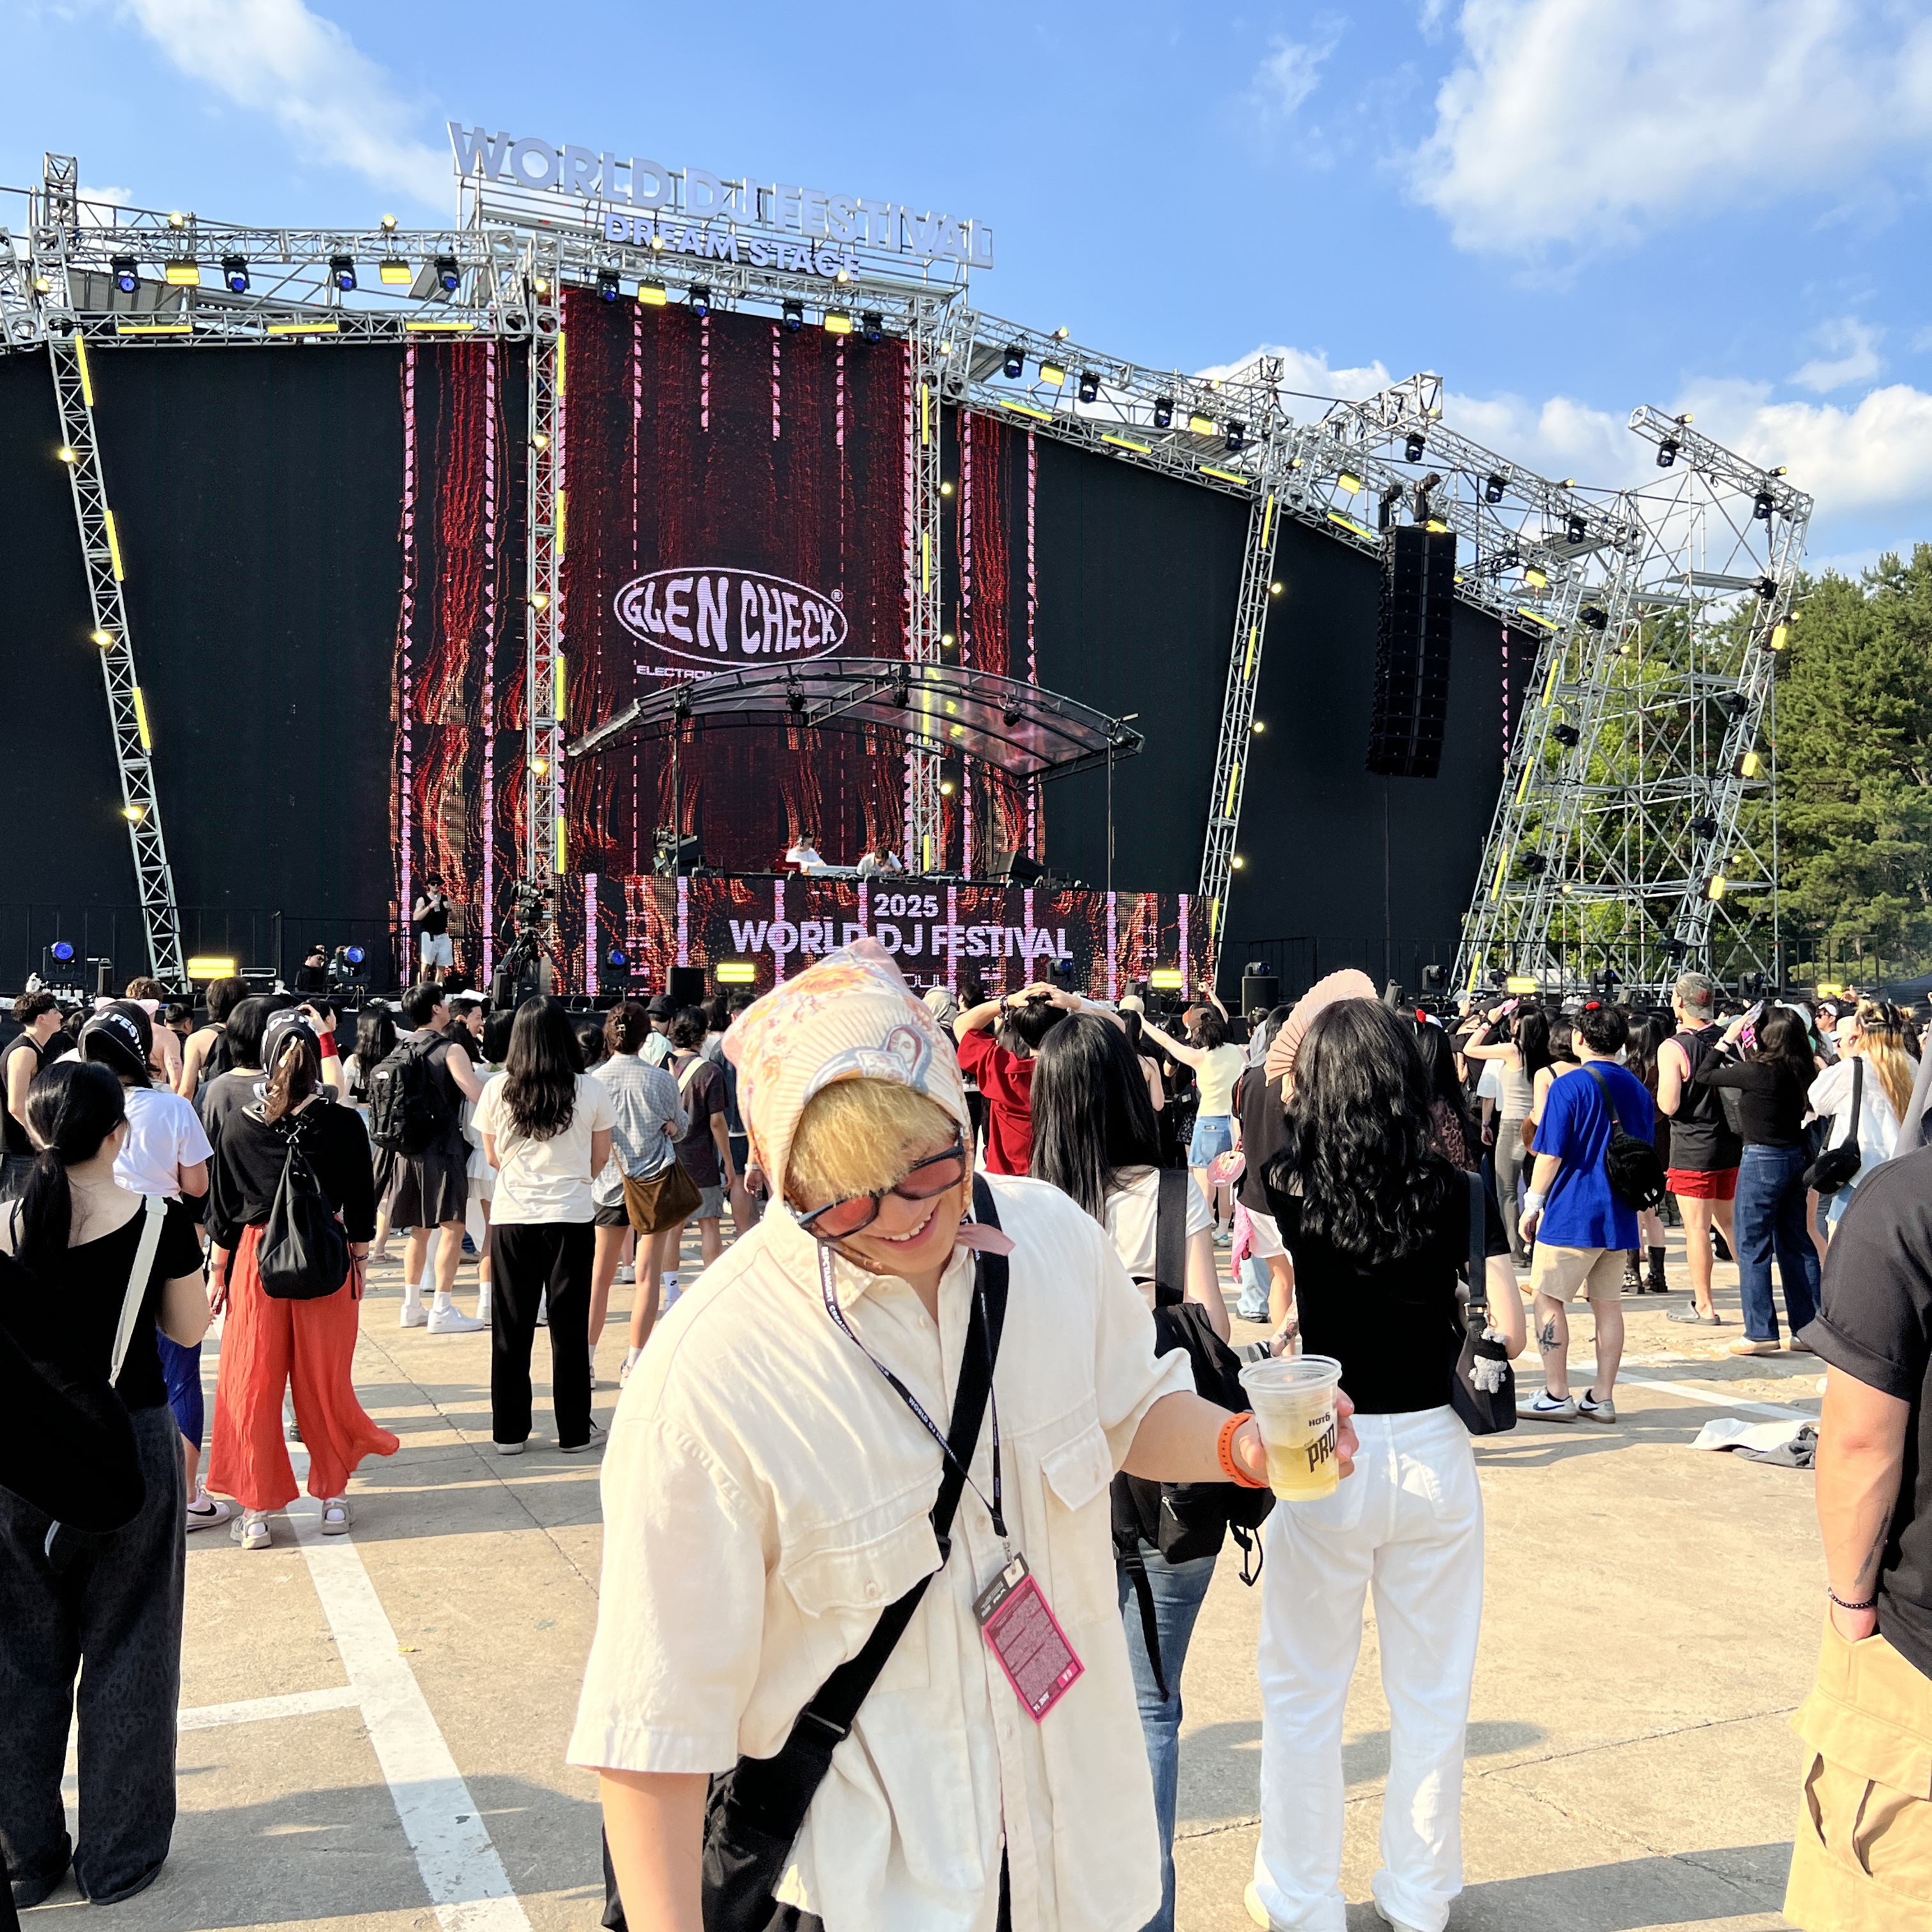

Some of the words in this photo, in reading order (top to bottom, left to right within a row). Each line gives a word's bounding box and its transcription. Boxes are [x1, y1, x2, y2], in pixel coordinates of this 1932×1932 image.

[447, 121, 671, 210] WORLD
[683, 167, 757, 226] DJ
[772, 183, 994, 270] FESTIVAL
[604, 212, 739, 263] DREAM
[748, 238, 861, 281] STAGE
[623, 576, 728, 652] GLEN
[740, 580, 837, 654] CHECK
[873, 893, 939, 917] 2025
[728, 919, 869, 954] WORLD
[876, 923, 924, 956] DJ
[931, 924, 1074, 959] FESTIVAL
[1305, 1423, 1335, 1473] PRO
